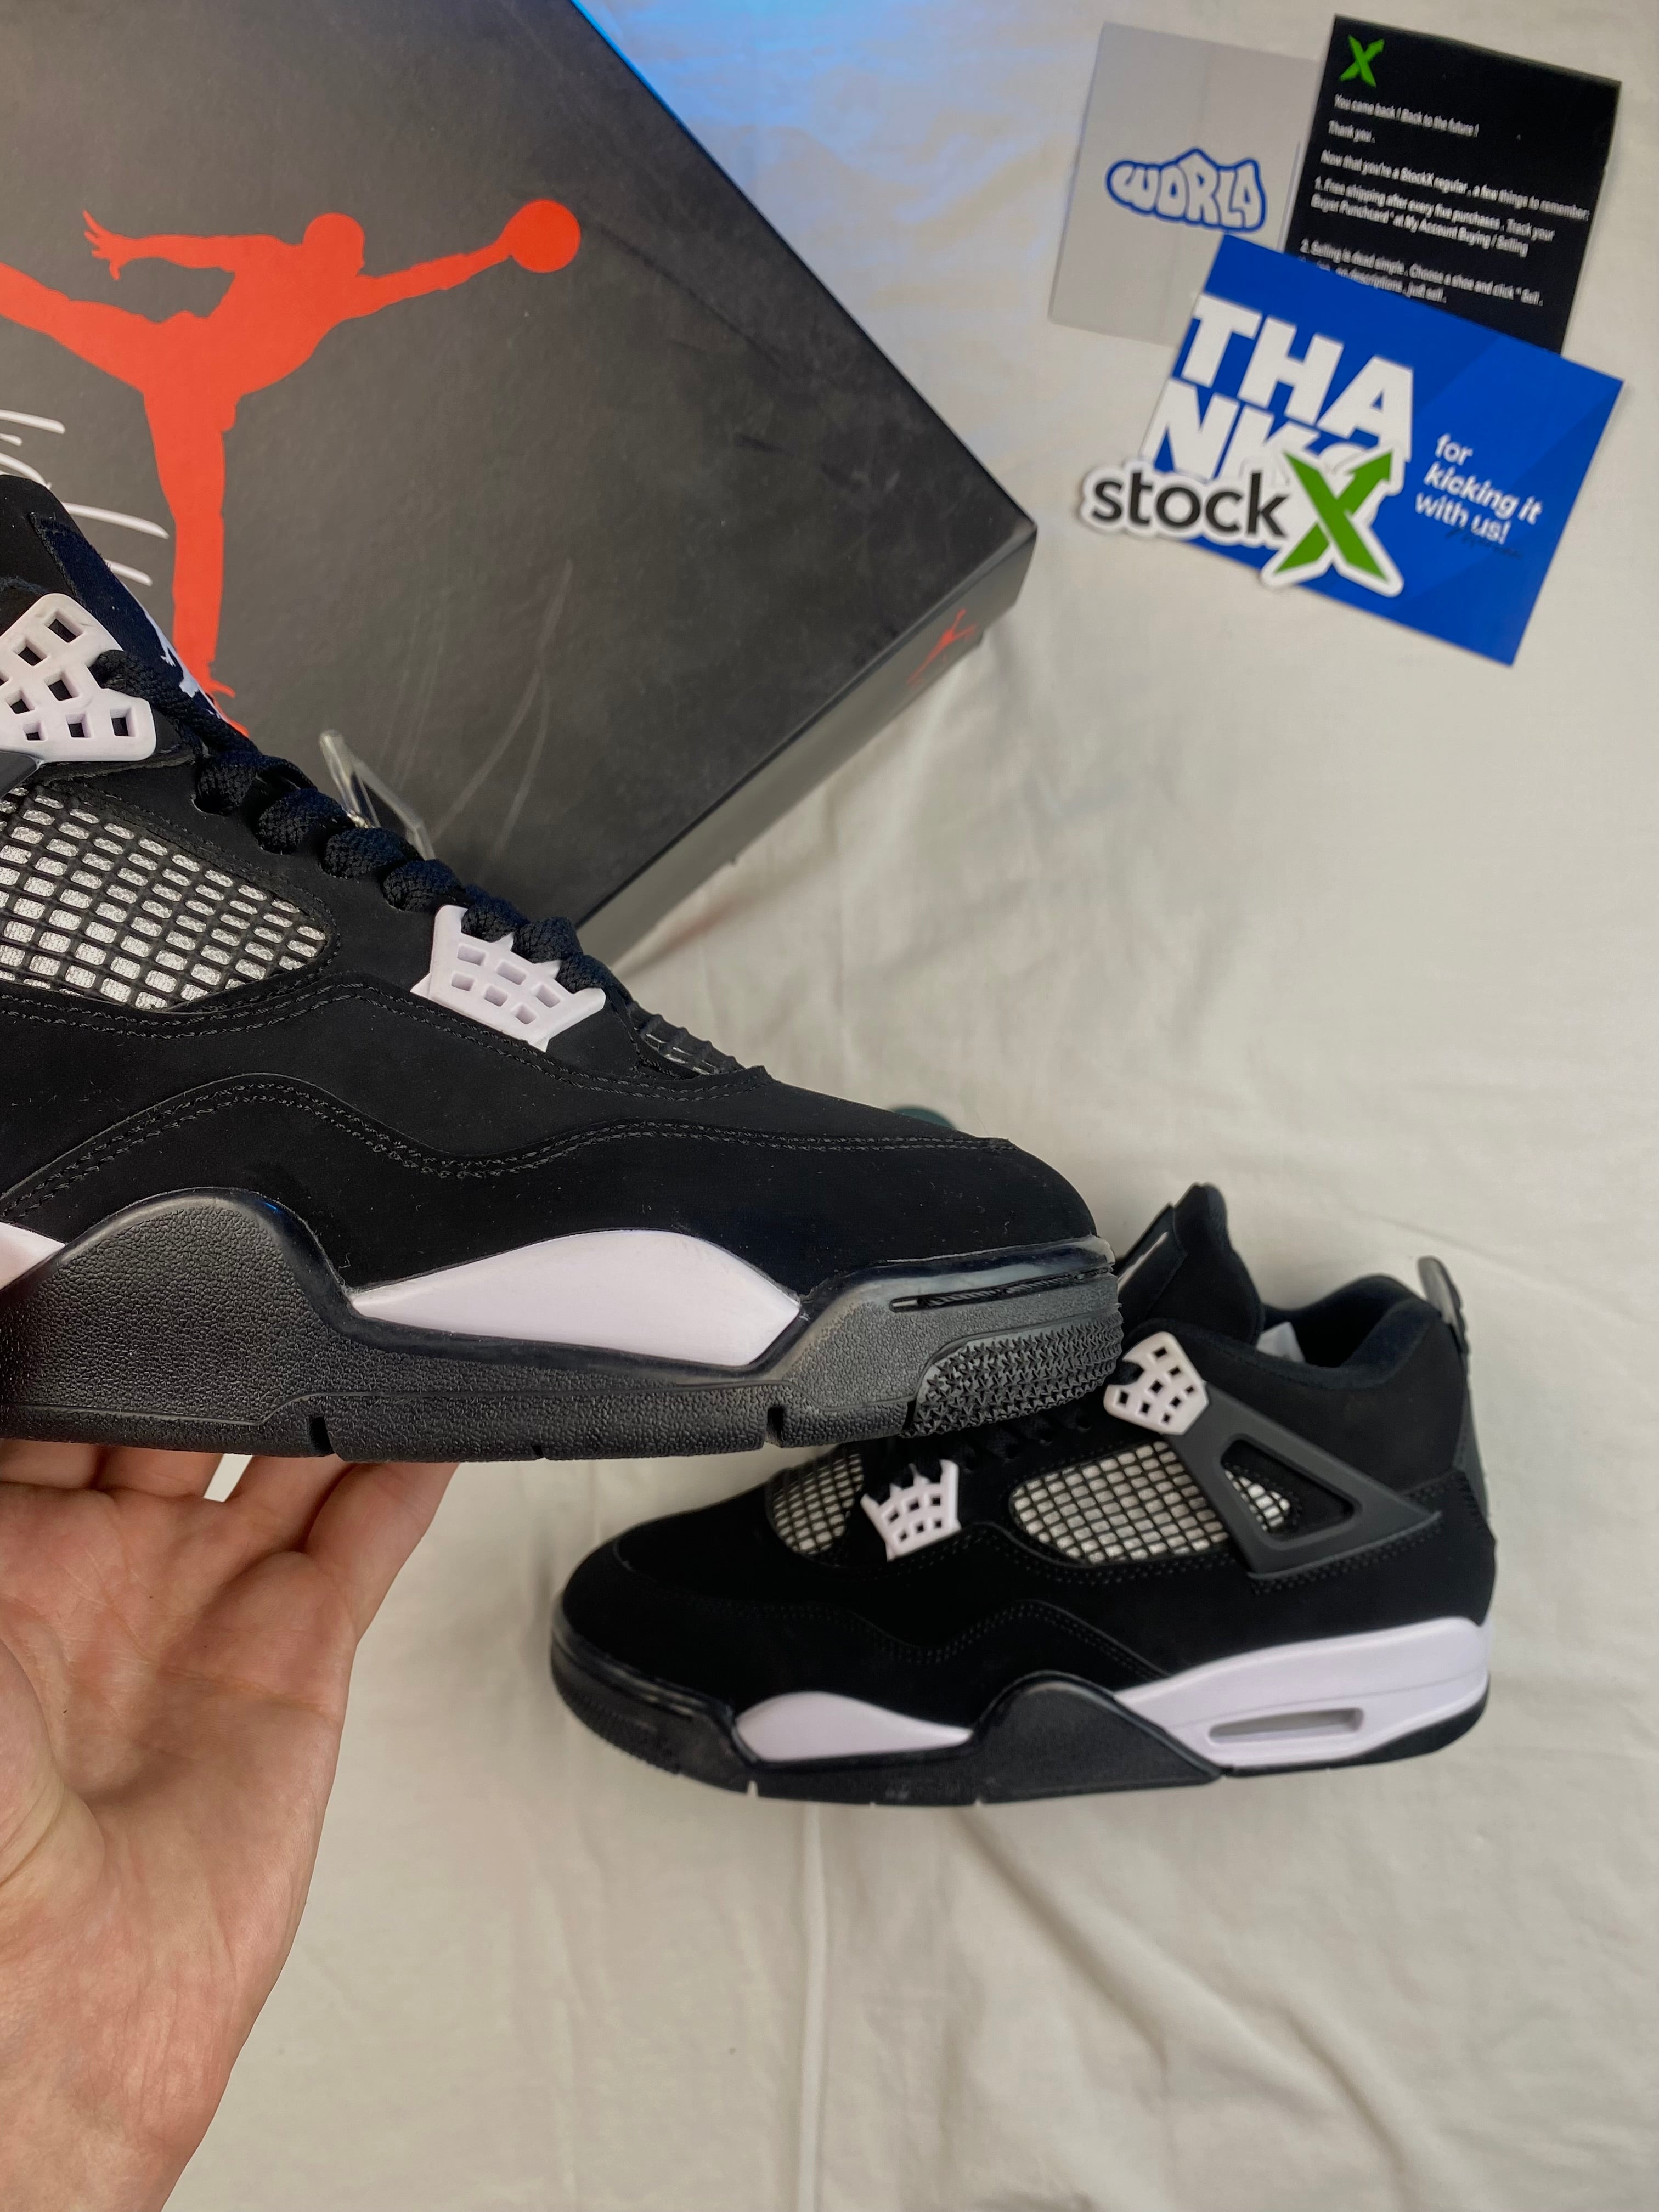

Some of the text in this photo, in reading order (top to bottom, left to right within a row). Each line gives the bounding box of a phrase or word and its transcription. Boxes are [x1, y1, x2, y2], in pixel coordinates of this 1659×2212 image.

[1105, 147, 1267, 233] WORLD
[1180, 293, 1414, 462] THA
[1139, 377, 1374, 483] NK
[1435, 433, 1473, 466] for
[1415, 492, 1470, 530] with
[1470, 515, 1512, 545] us!
[1423, 460, 1543, 525] kicking it
